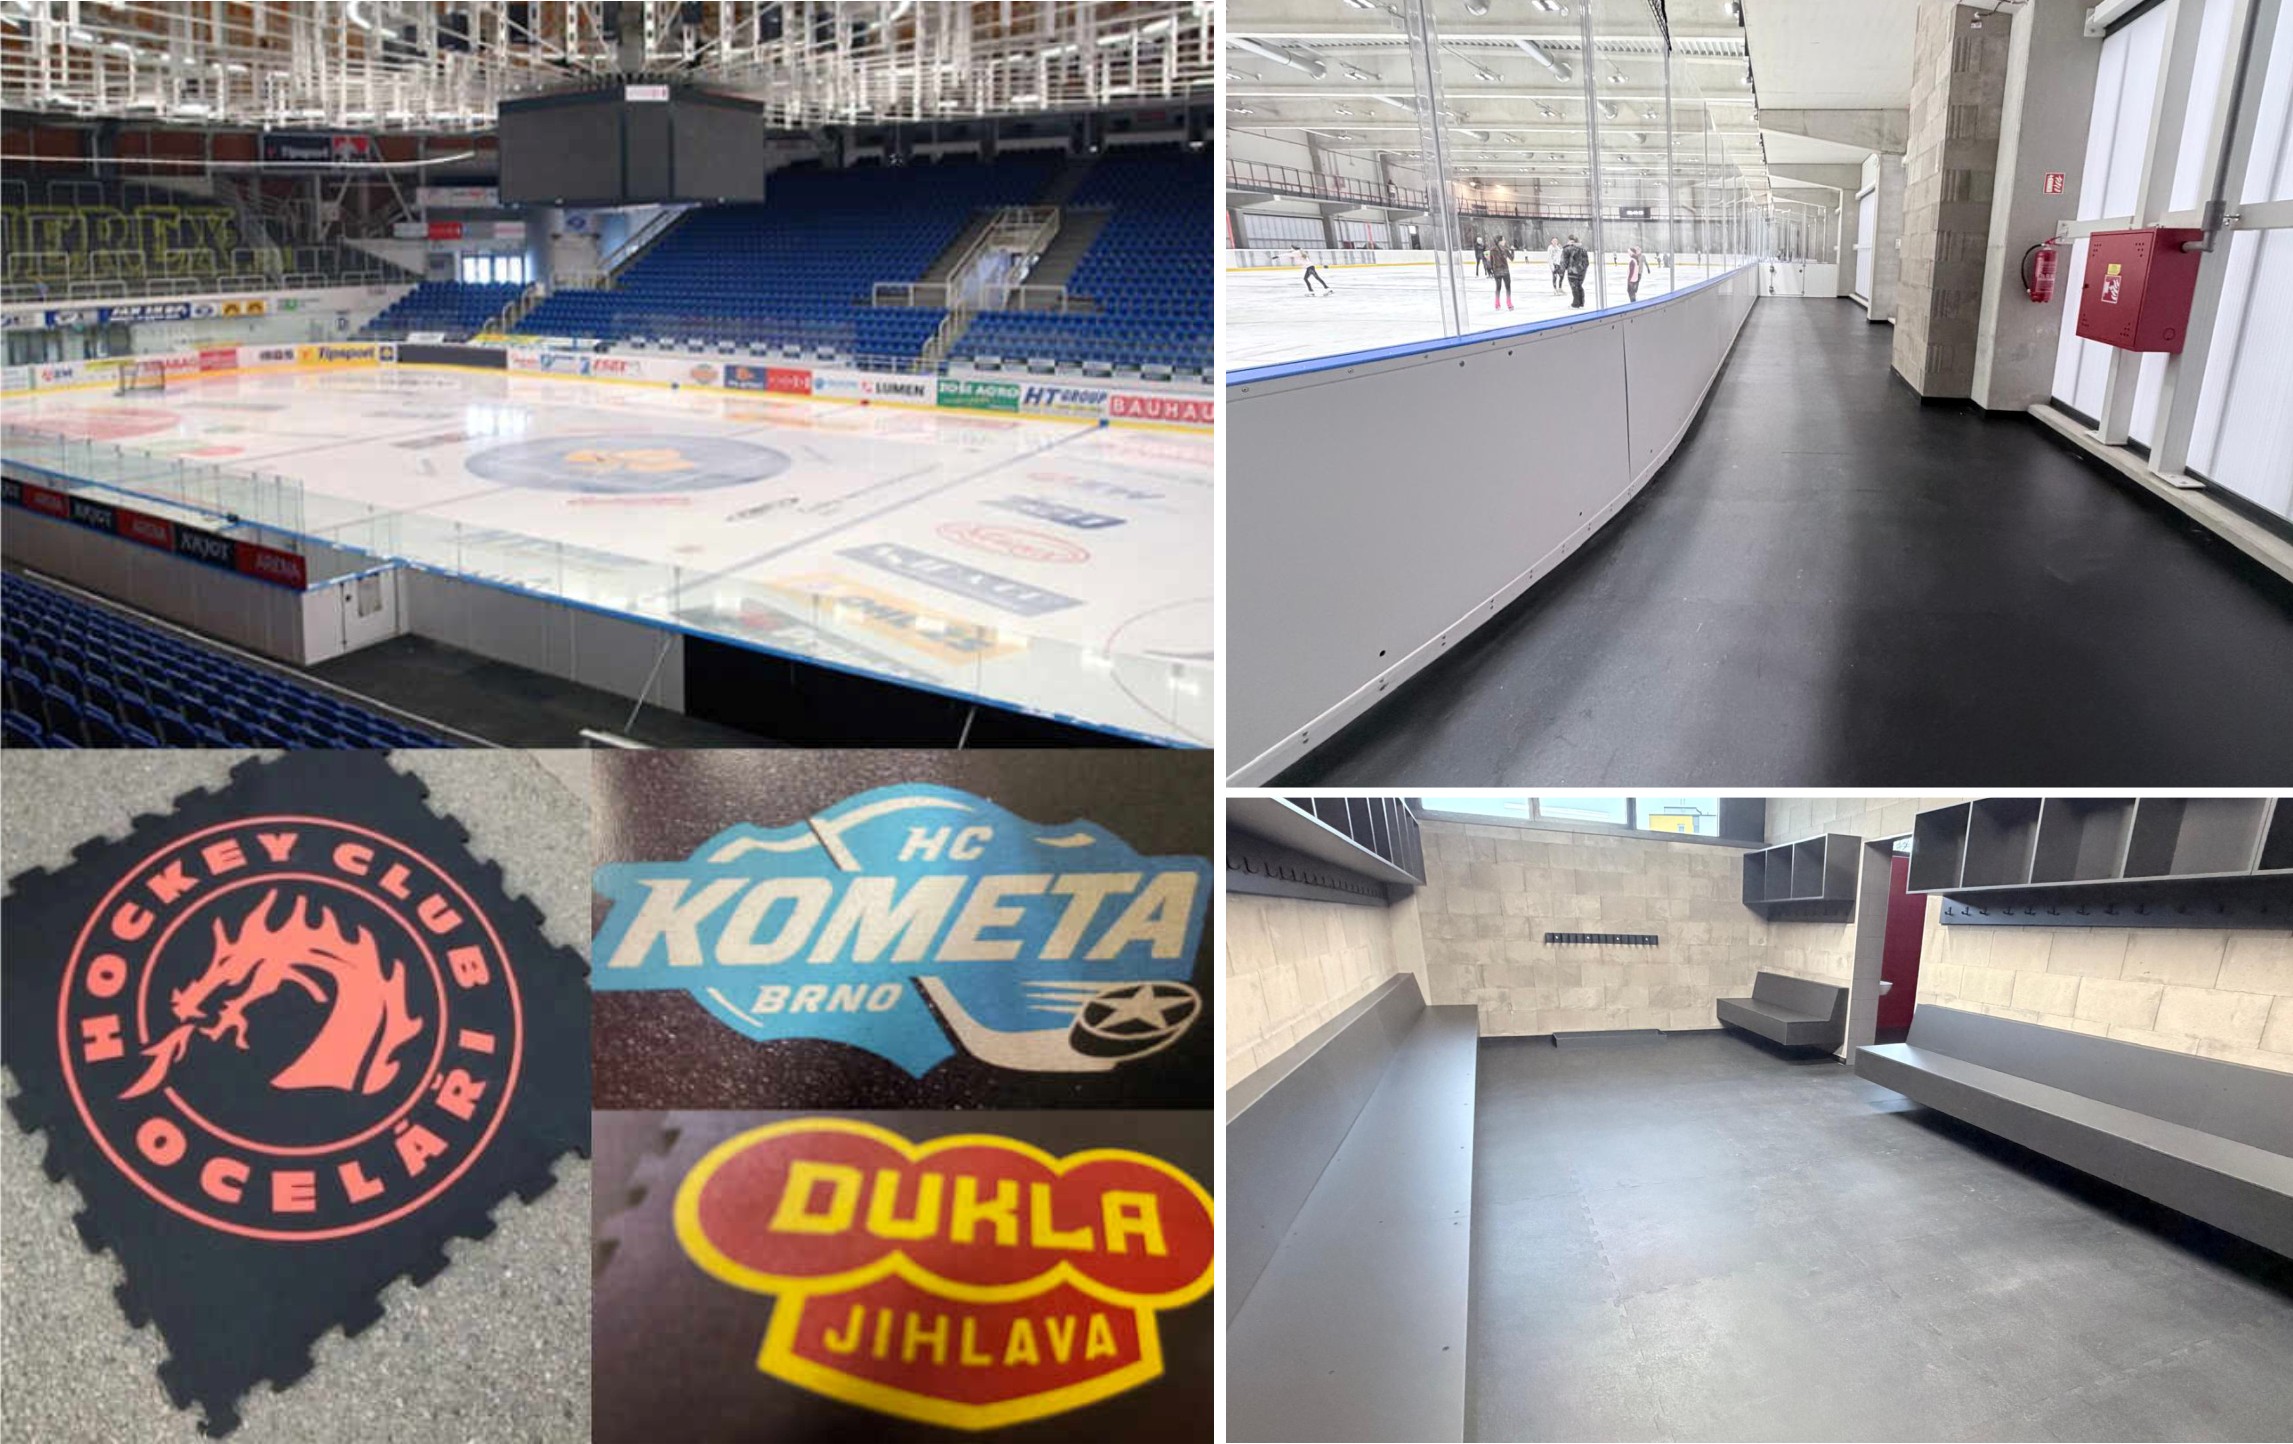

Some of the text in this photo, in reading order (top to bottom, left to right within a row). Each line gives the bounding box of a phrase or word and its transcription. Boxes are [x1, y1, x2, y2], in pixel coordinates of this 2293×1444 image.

[318, 345, 375, 362] Tipsport
[875, 380, 925, 397] LUMEN
[1024, 386, 1061, 406] HT
[1061, 389, 1108, 404] GROUP
[898, 827, 993, 862] HC
[607, 871, 1199, 969] KOMETA
[81, 832, 490, 1062] HOCKEY CLUB
[750, 983, 904, 1016] BRNO
[136, 1028, 496, 1213] OCELÁŘI
[769, 1160, 1168, 1257] DUKLA
[823, 1304, 1118, 1367] JIHLAVA
